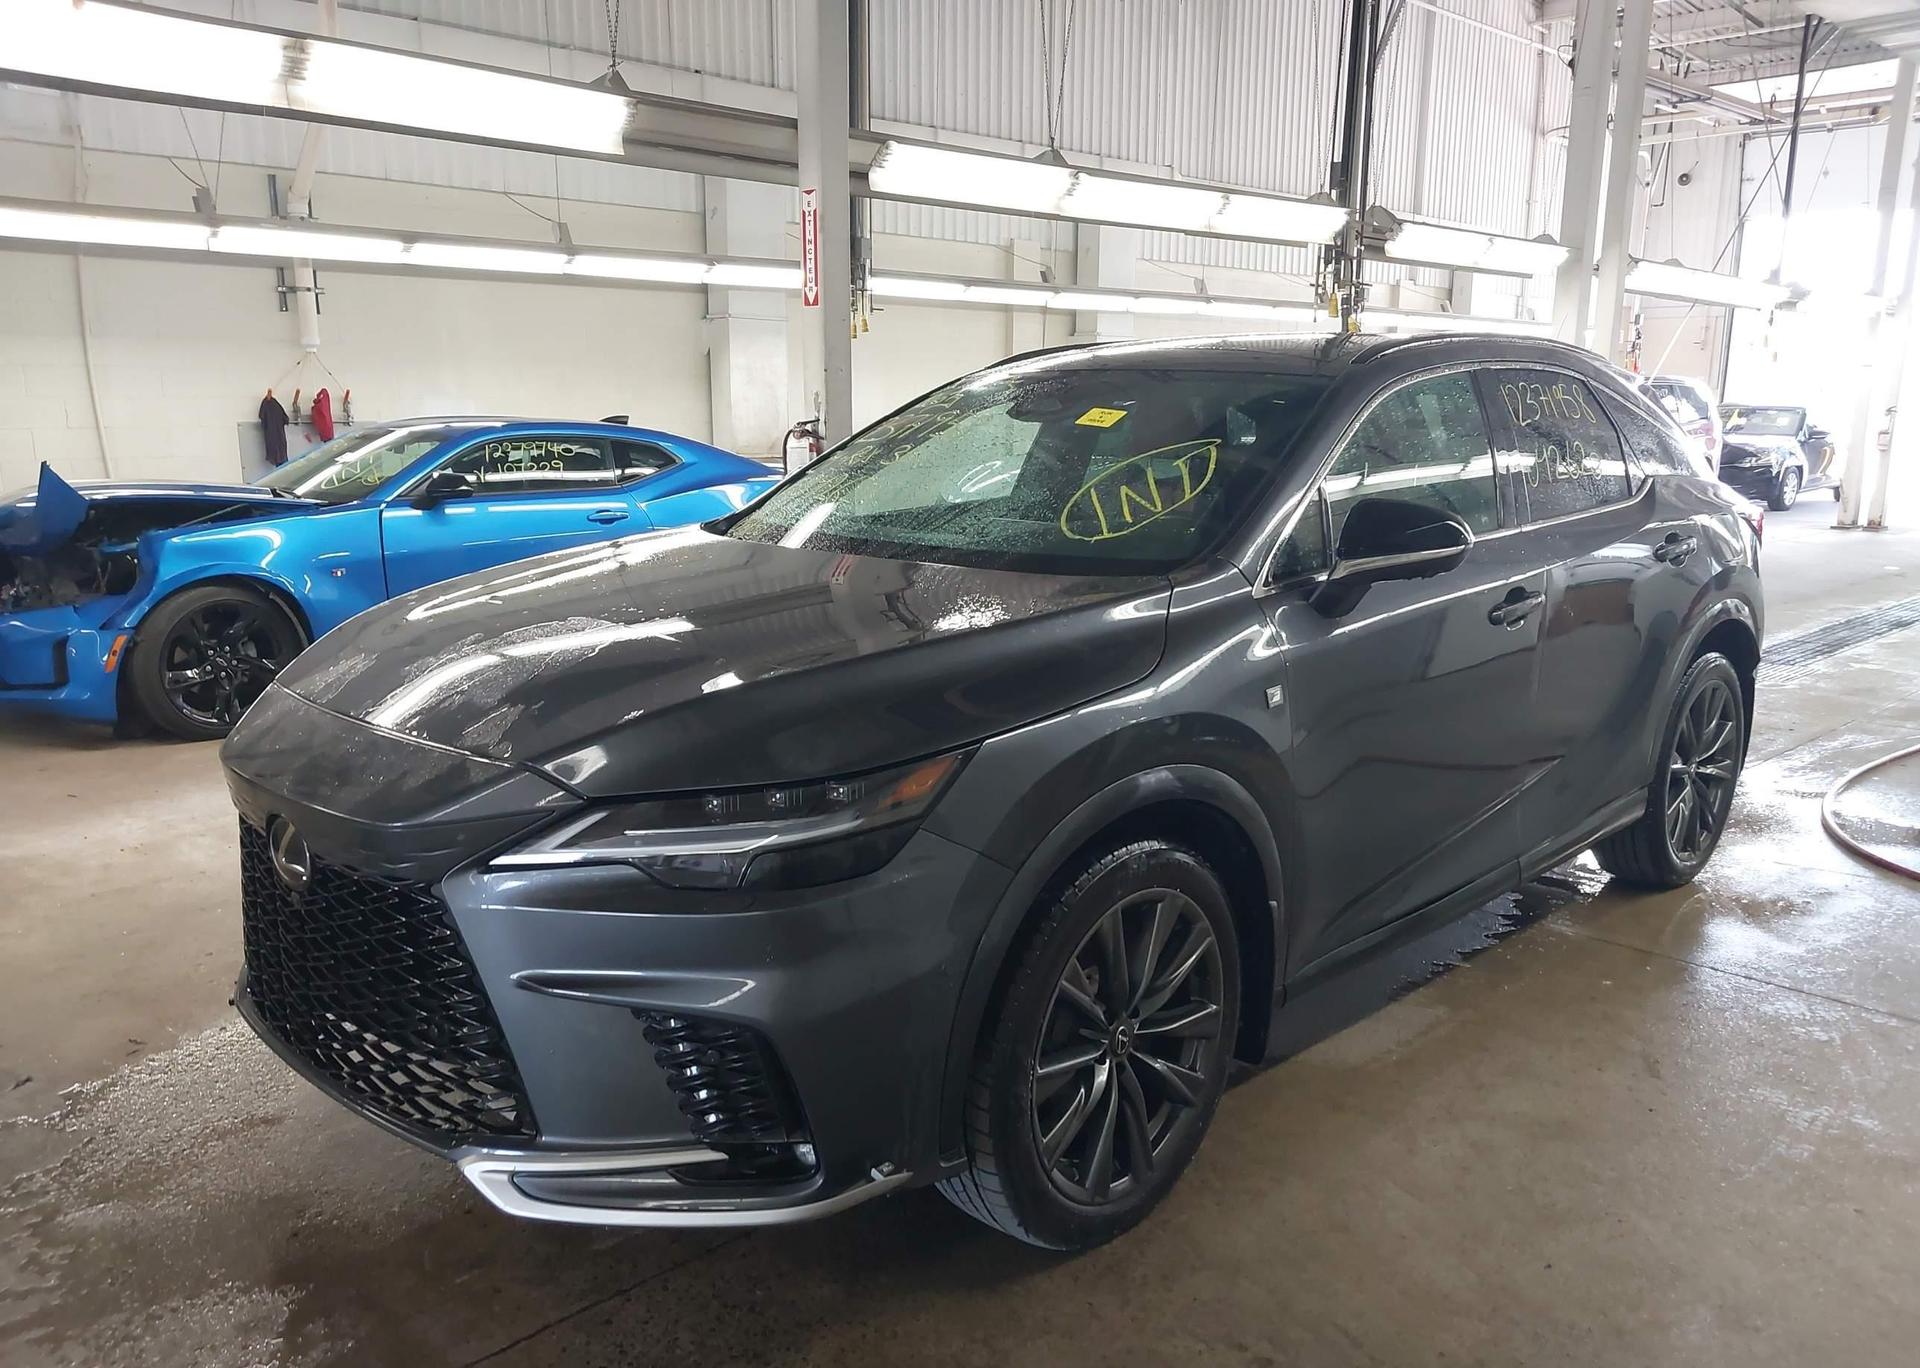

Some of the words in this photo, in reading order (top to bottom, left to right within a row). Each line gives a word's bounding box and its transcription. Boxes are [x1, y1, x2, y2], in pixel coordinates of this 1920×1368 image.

[806, 200, 814, 293] EXTINCTEUR
[1500, 382, 1597, 426] 12371958
[1090, 445, 1216, 537] INT
